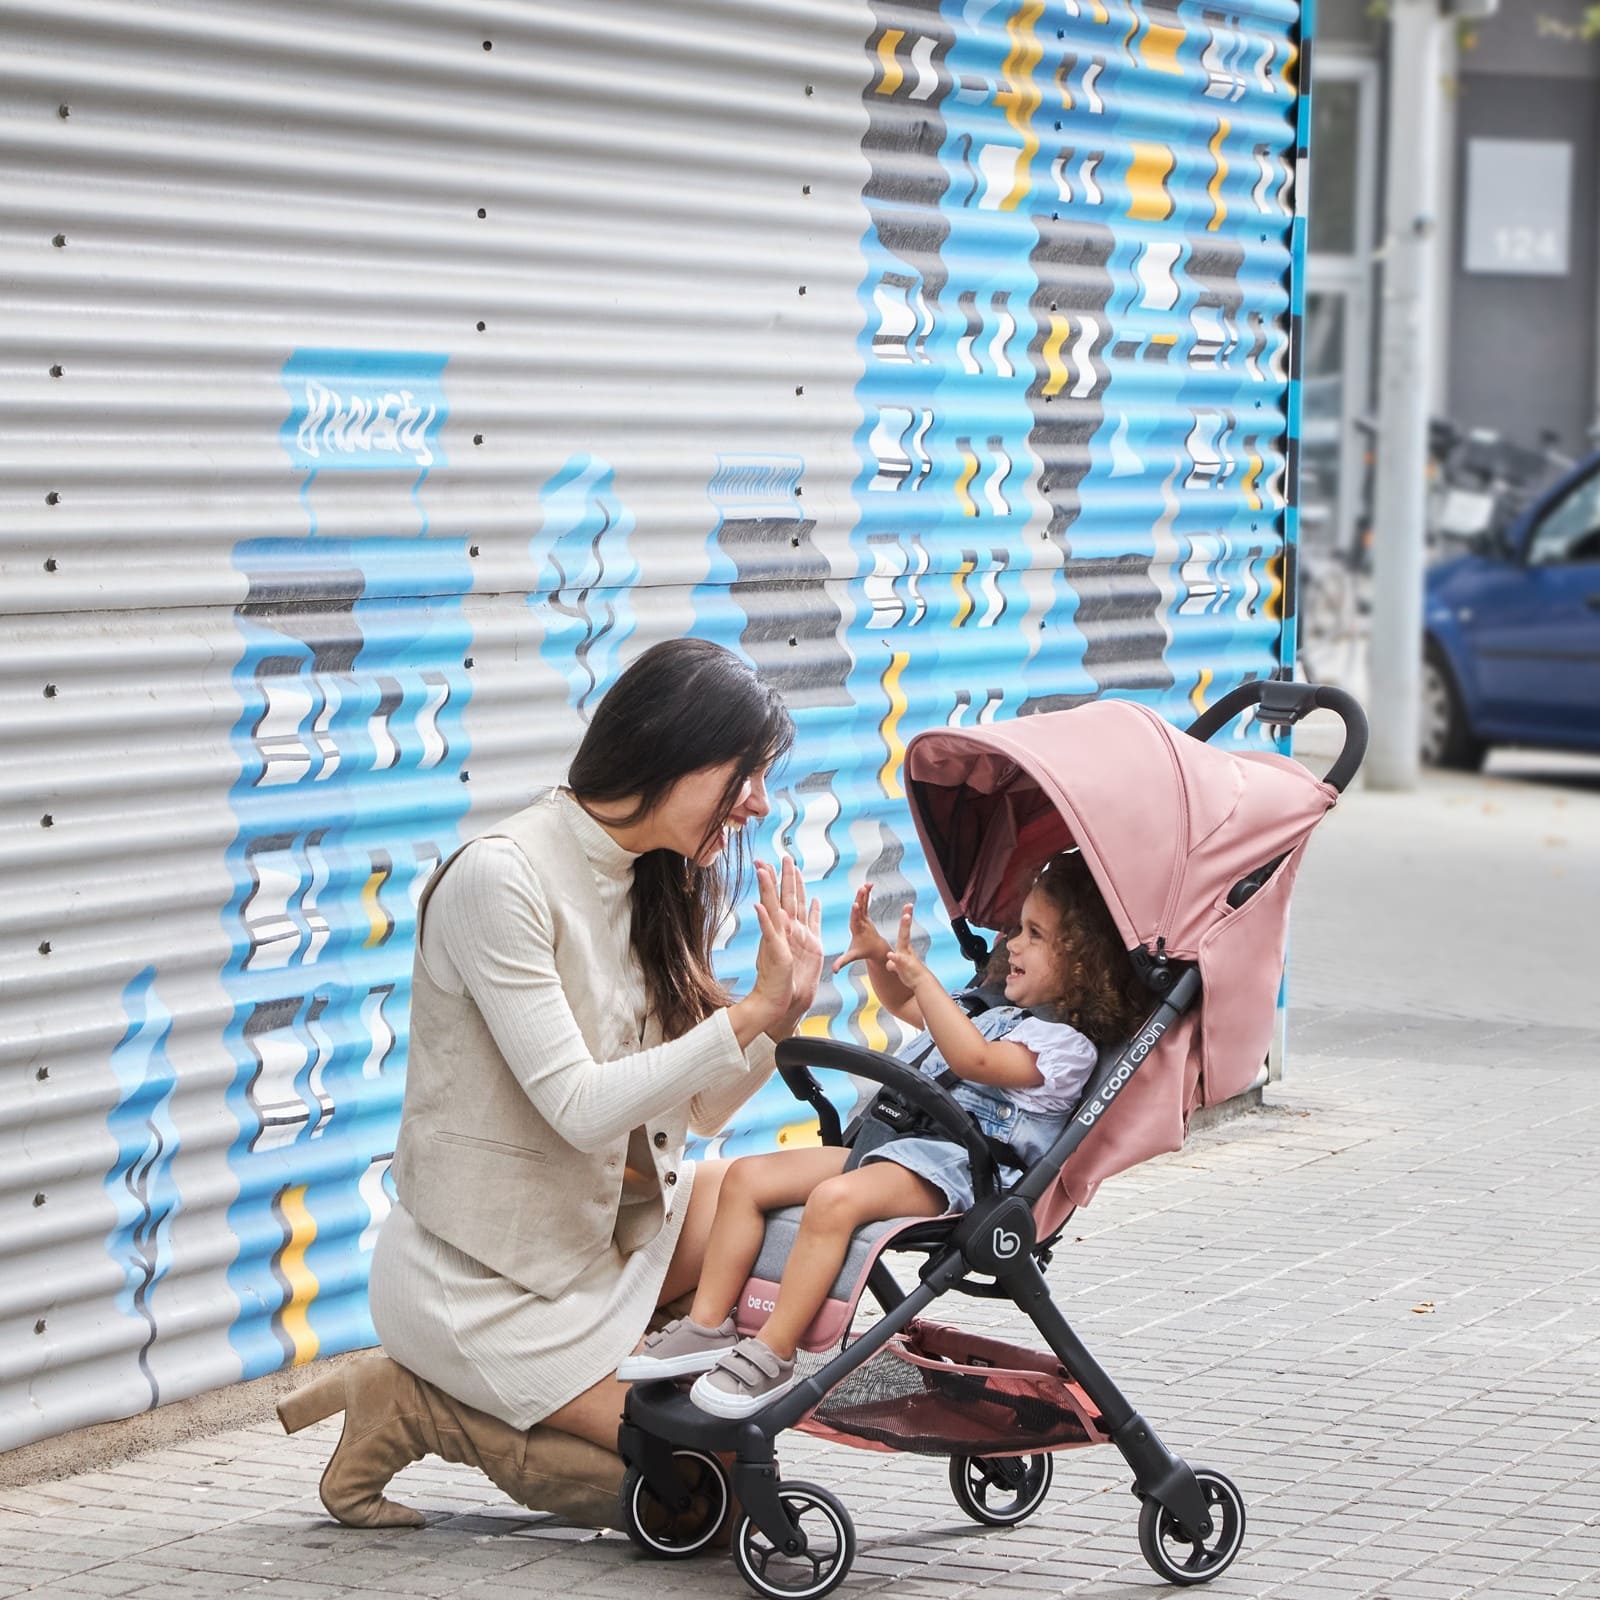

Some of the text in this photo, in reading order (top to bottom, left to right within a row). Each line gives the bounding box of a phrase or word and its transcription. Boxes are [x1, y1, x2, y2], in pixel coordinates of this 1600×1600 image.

[1495, 228, 1556, 259] 124
[1078, 1022, 1166, 1126] be cool cabin
[747, 1295, 776, 1313] be co
